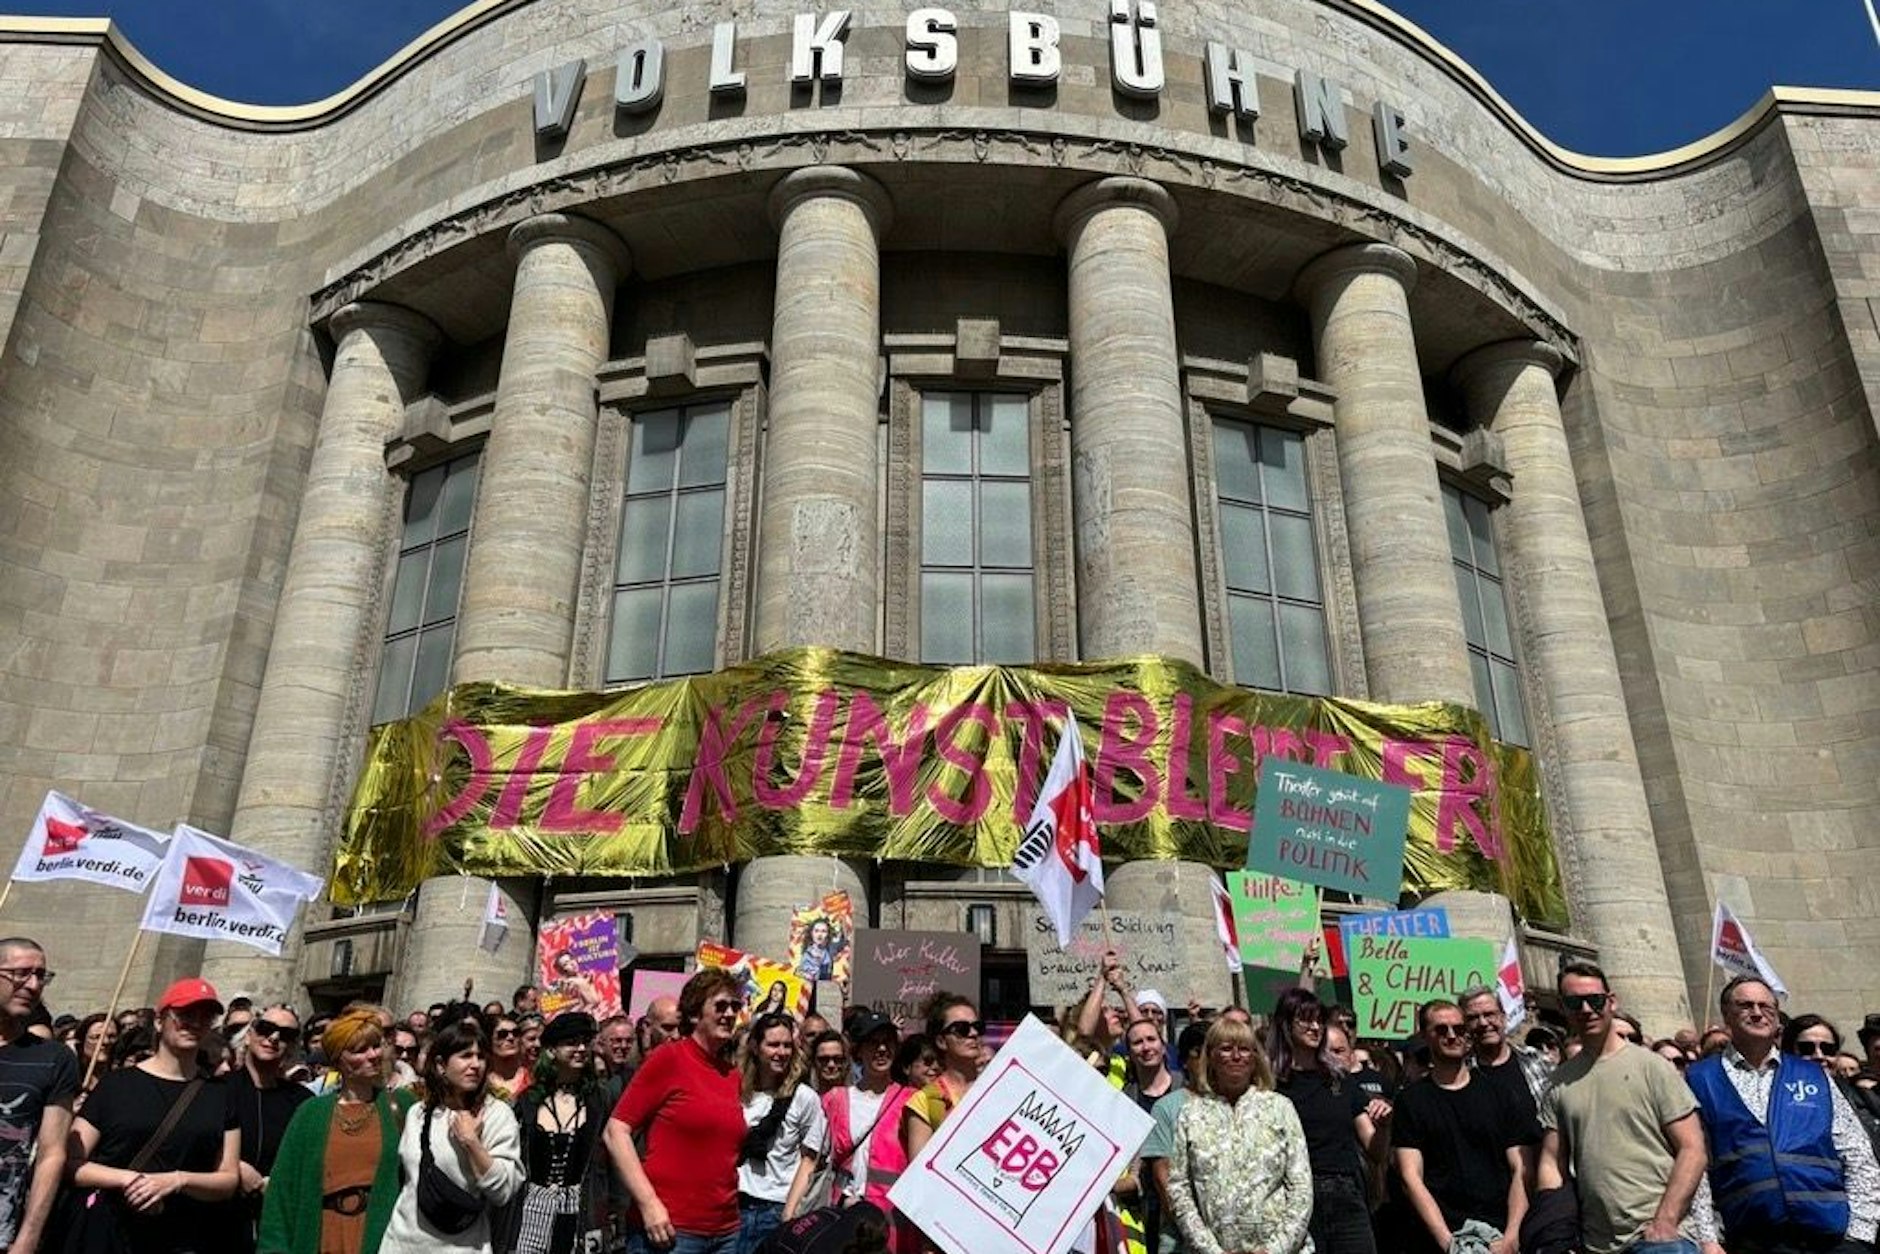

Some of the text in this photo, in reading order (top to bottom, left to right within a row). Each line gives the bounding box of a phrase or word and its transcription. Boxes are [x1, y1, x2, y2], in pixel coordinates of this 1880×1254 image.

[534, 0, 1412, 178] VOLKSBÜHNE
[677, 688, 1070, 834] KUNST
[1357, 972, 1374, 996] &
[1359, 936, 1409, 961] Bella
[981, 1118, 1060, 1192] EBB
